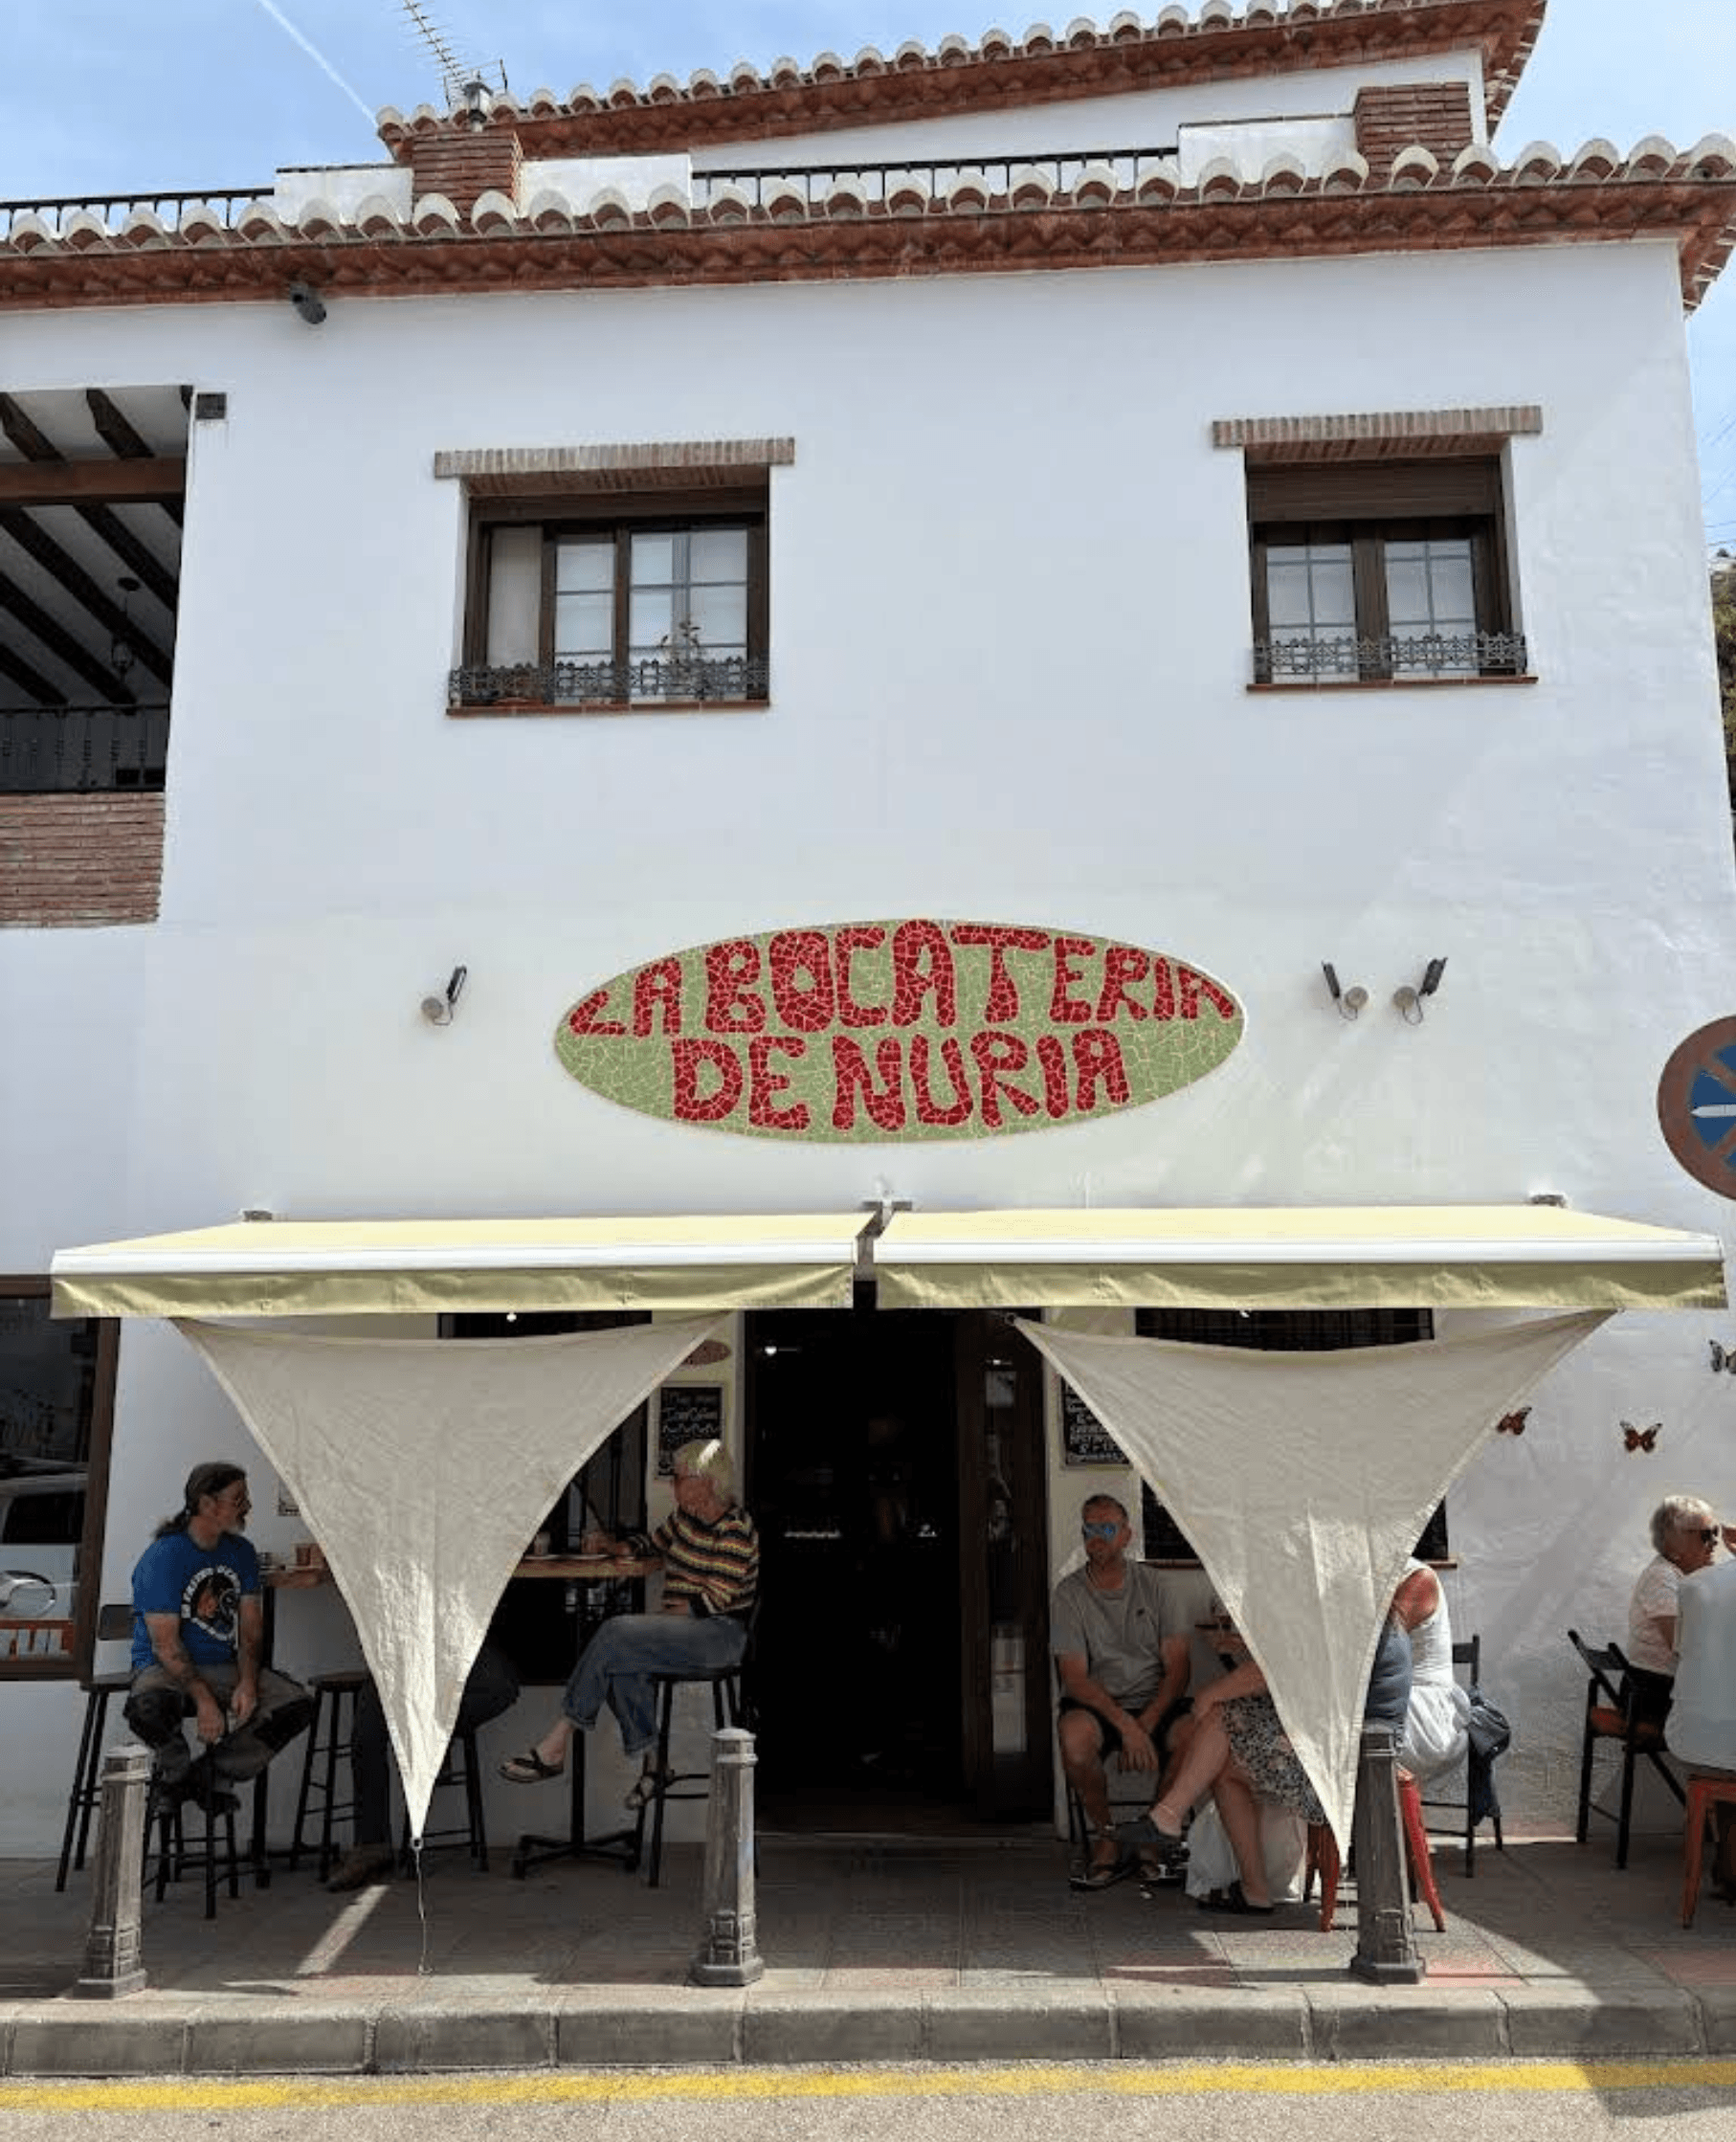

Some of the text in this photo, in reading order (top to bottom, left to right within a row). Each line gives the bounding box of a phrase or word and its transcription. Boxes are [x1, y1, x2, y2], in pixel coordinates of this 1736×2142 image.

[568, 919, 1235, 1038] LA BOCATERIA
[671, 1028, 1130, 1131] DE NURIA
